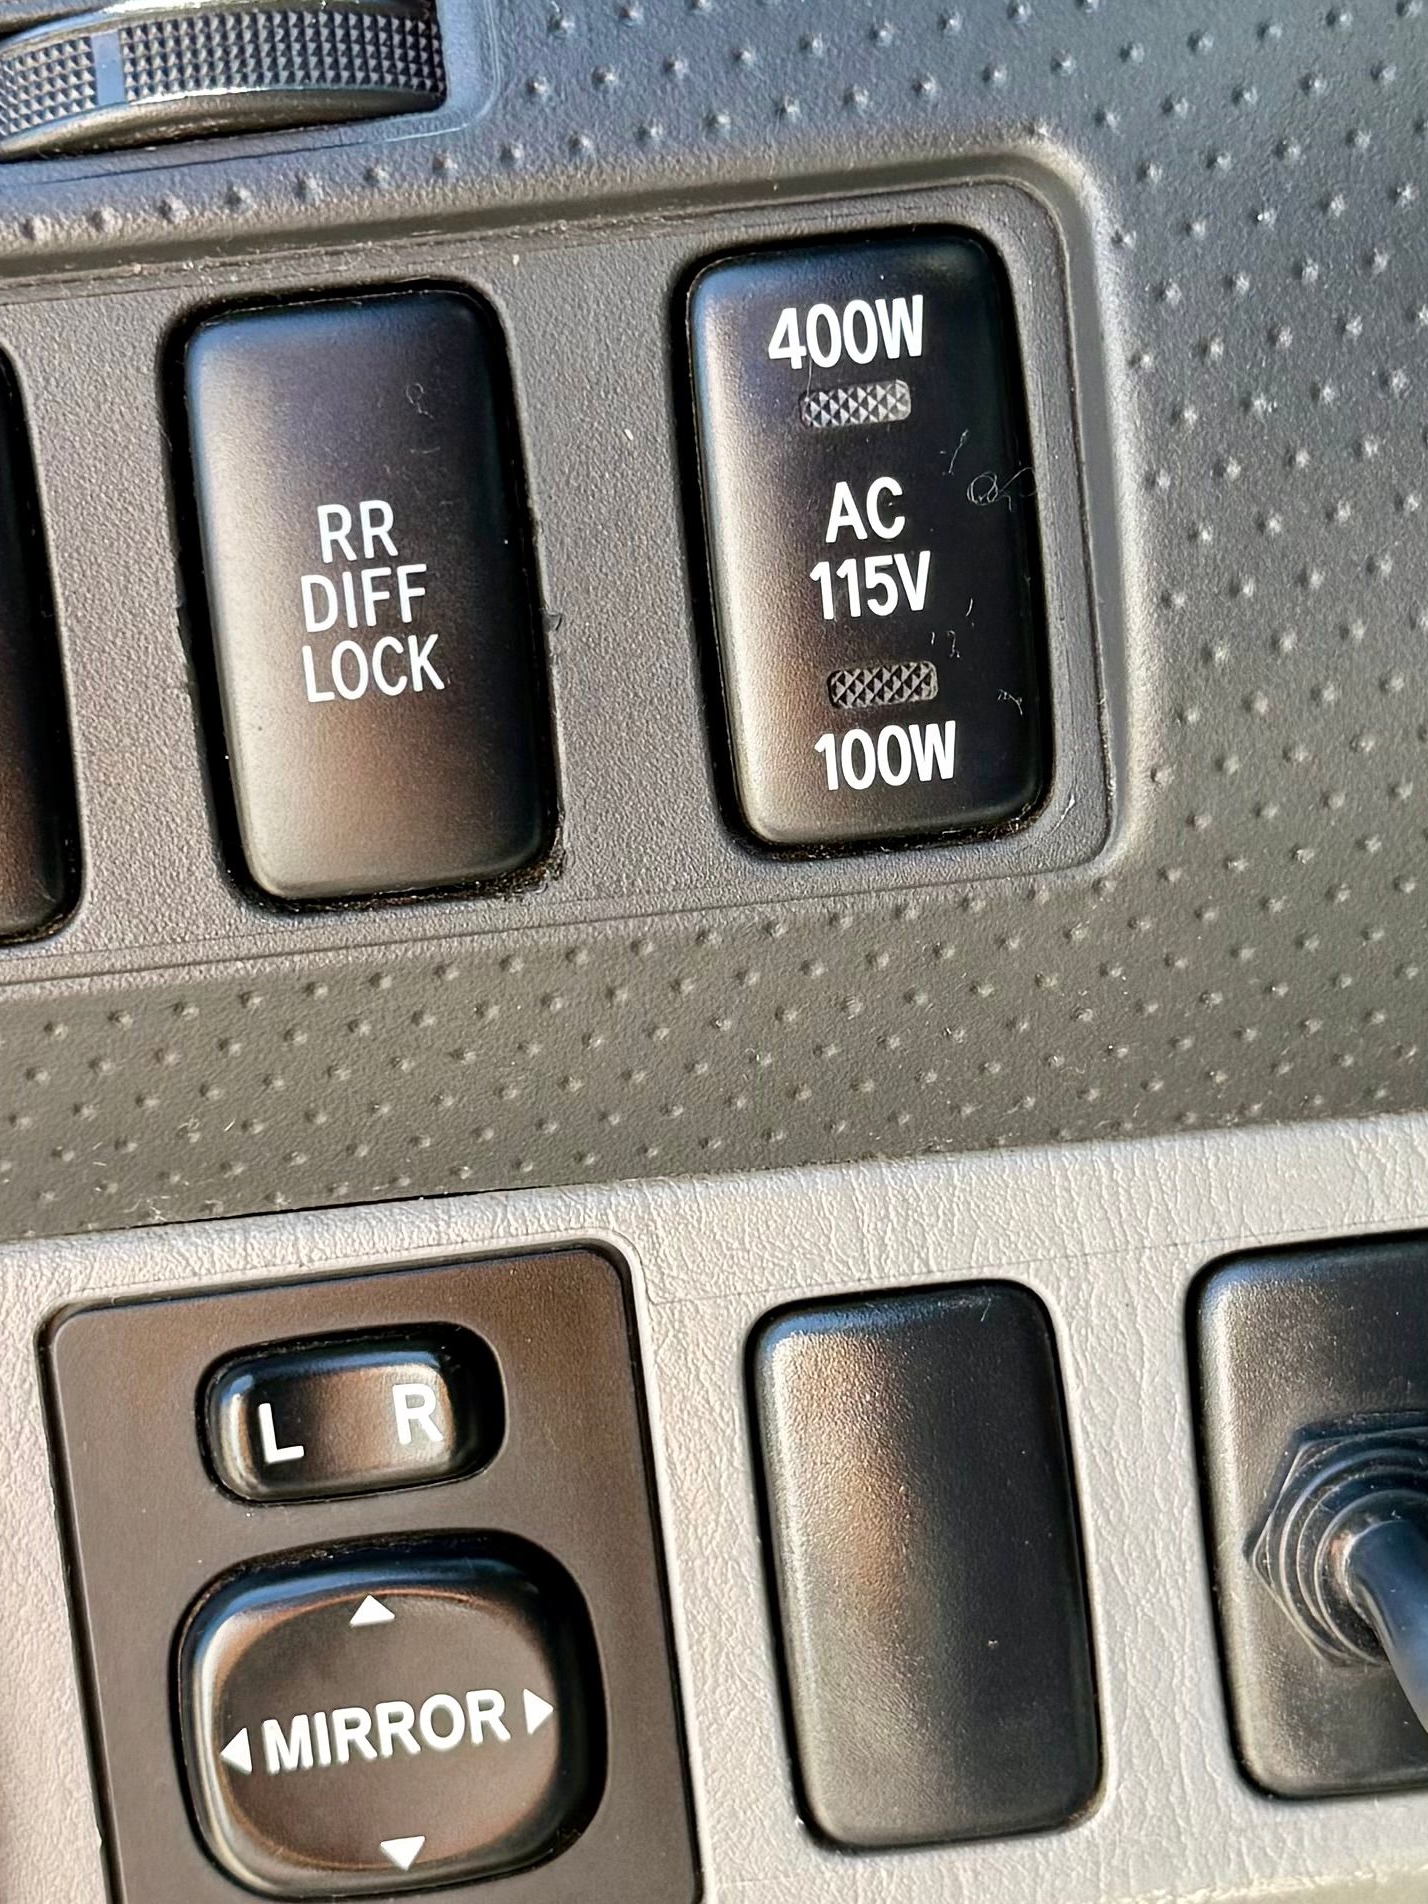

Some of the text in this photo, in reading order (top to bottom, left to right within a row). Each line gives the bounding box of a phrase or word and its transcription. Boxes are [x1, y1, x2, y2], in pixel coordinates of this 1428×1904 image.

[768, 294, 925, 370] 400W
[316, 499, 399, 564] RR
[824, 476, 906, 544] AC
[300, 563, 427, 633] DIFF
[809, 550, 932, 620] 115V
[301, 633, 445, 703] LOCK
[815, 720, 957, 791] 100W
[257, 1382, 445, 1465] L R
[260, 1687, 513, 1776] MIRROR
